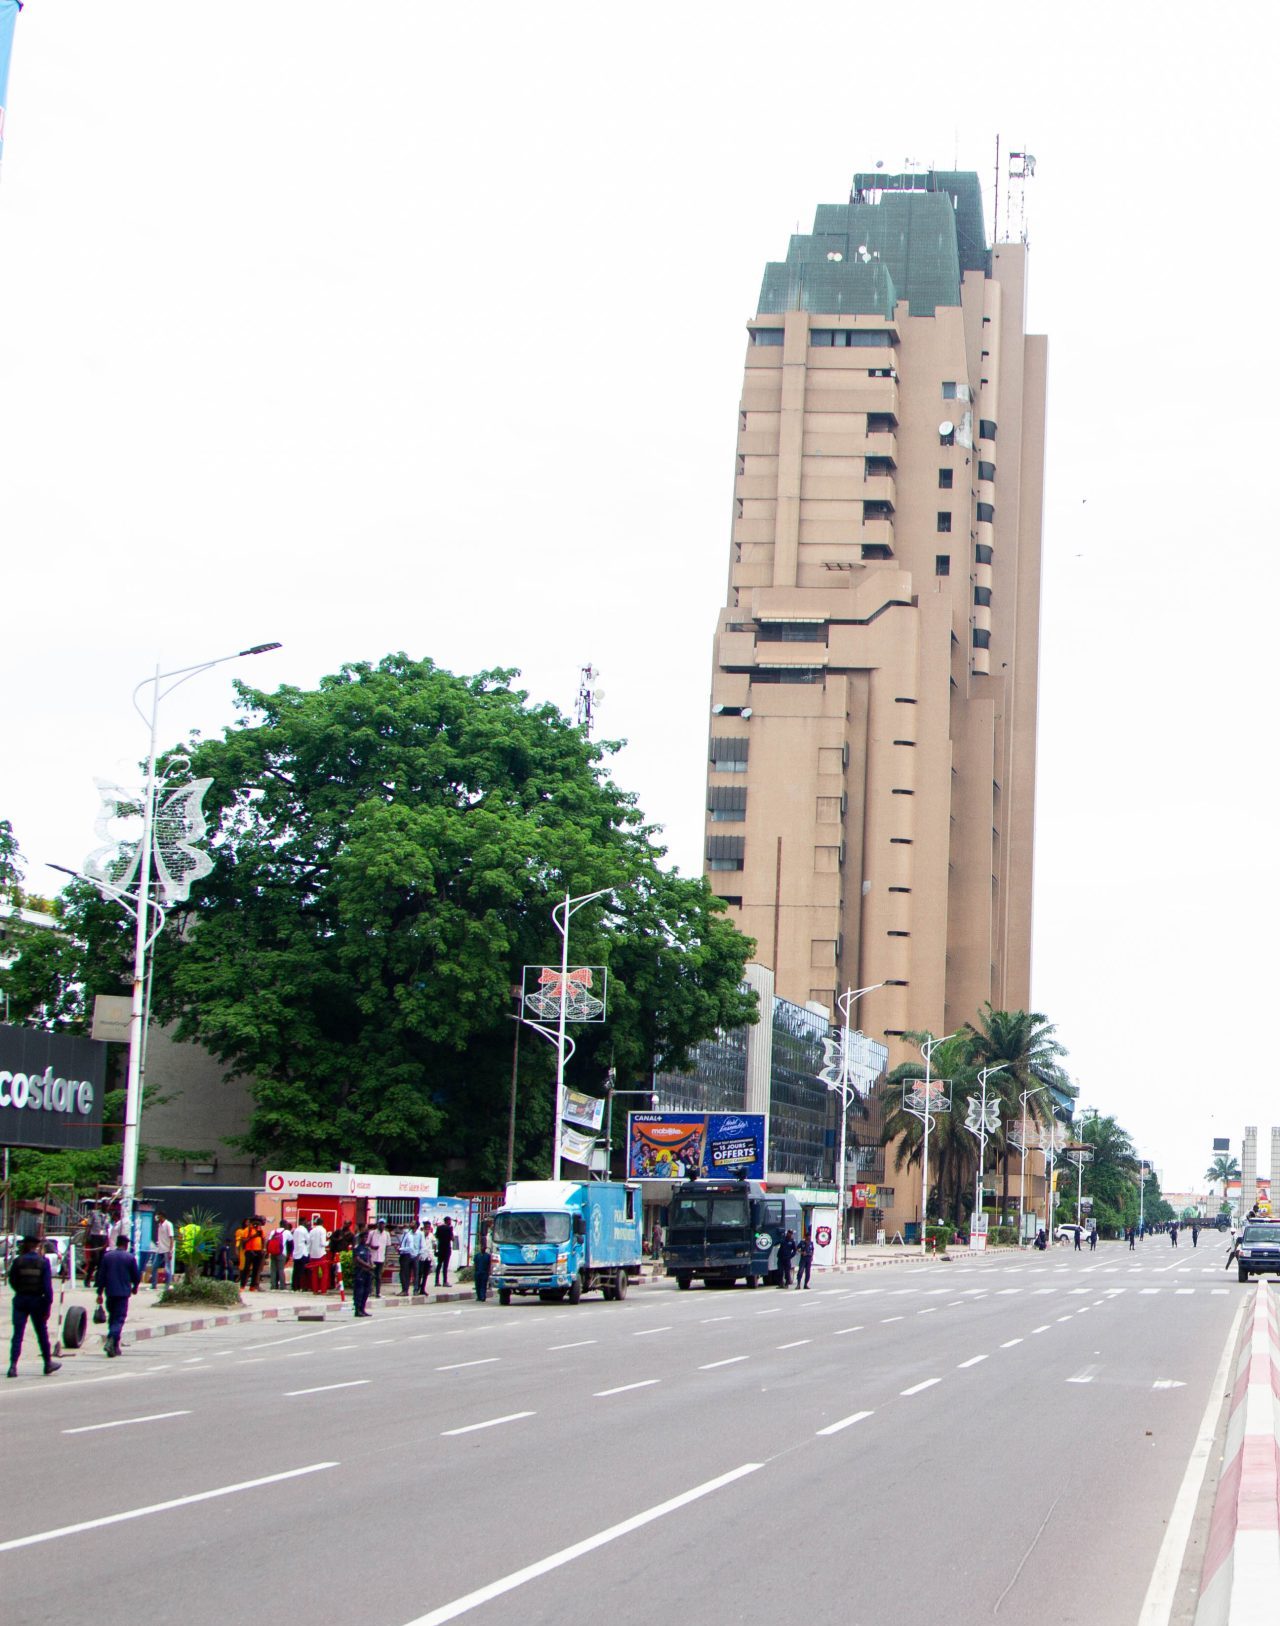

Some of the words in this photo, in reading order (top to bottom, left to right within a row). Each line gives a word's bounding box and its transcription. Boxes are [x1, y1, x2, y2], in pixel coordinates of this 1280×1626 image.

[0, 1066, 94, 1114] costore
[713, 1148, 755, 1160] OFFERTS
[288, 1179, 333, 1189] vodacom
